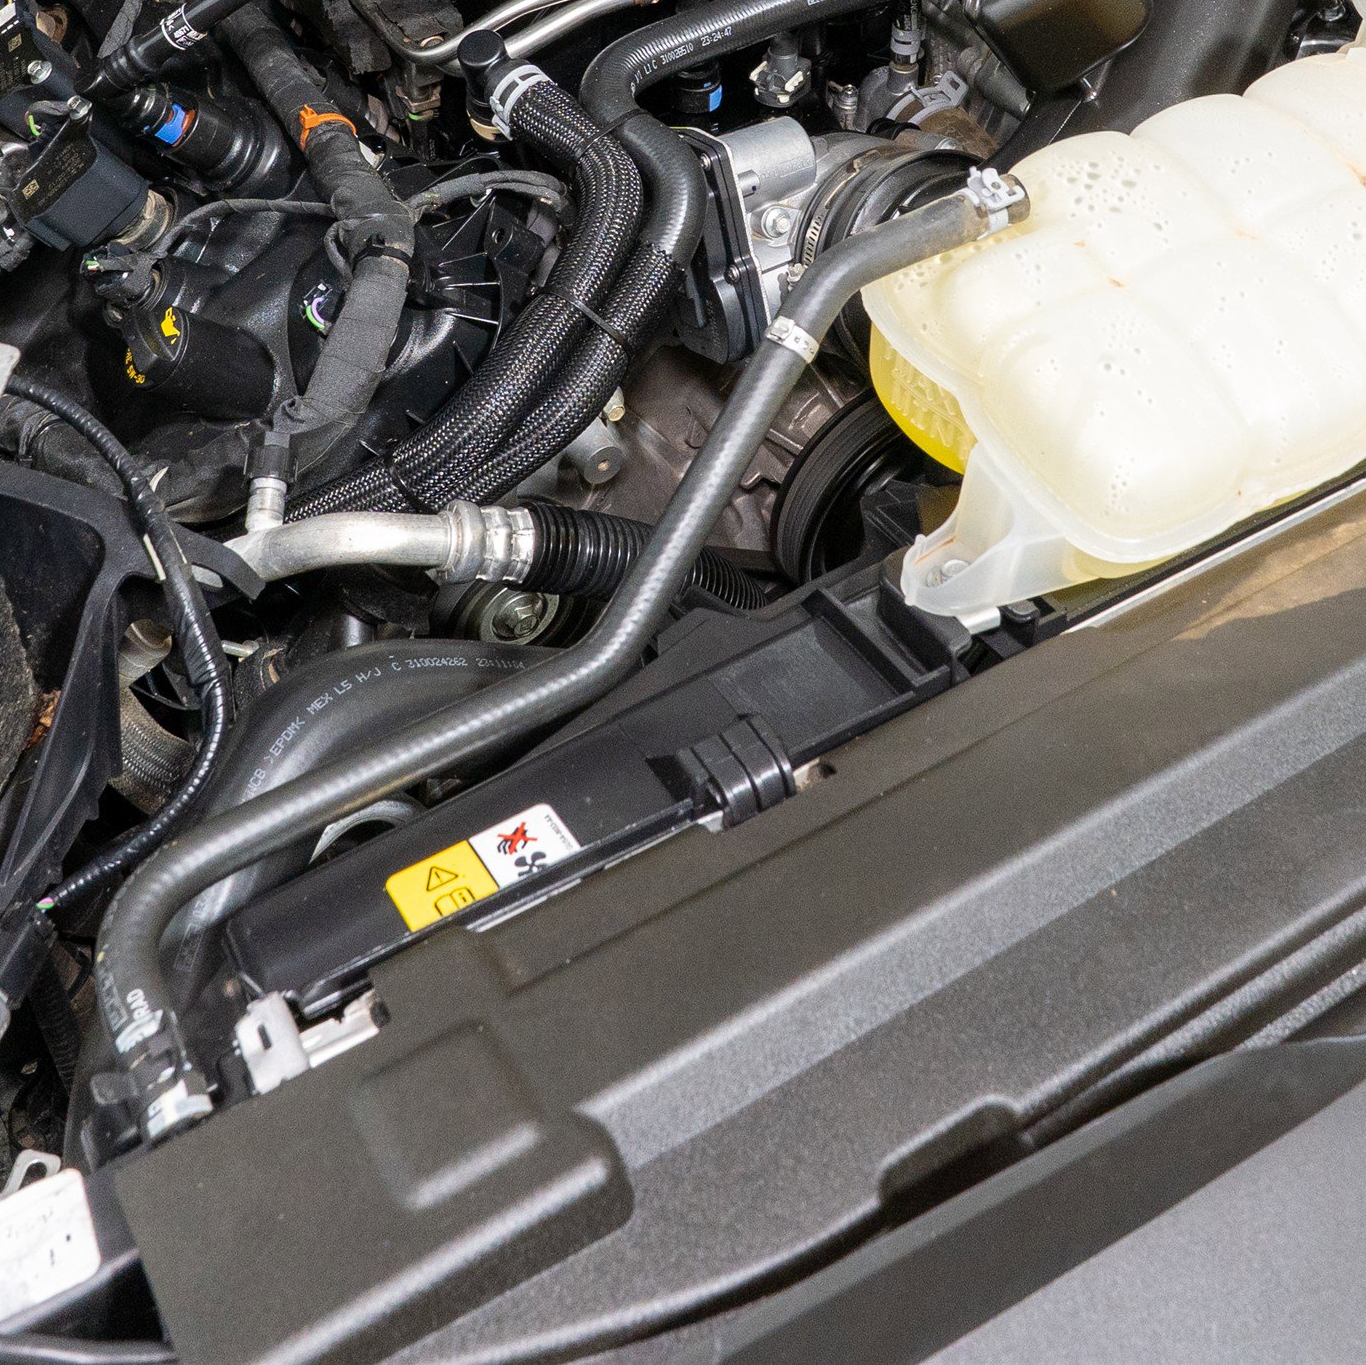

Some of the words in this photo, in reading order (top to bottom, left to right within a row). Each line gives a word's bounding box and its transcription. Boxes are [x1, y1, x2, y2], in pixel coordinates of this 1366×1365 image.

[306, 692, 335, 715] MEX
[333, 679, 353, 695] L5
[356, 667, 382, 684] H/J
[405, 657, 468, 669] 310024262
[125, 987, 151, 1020] RAD
